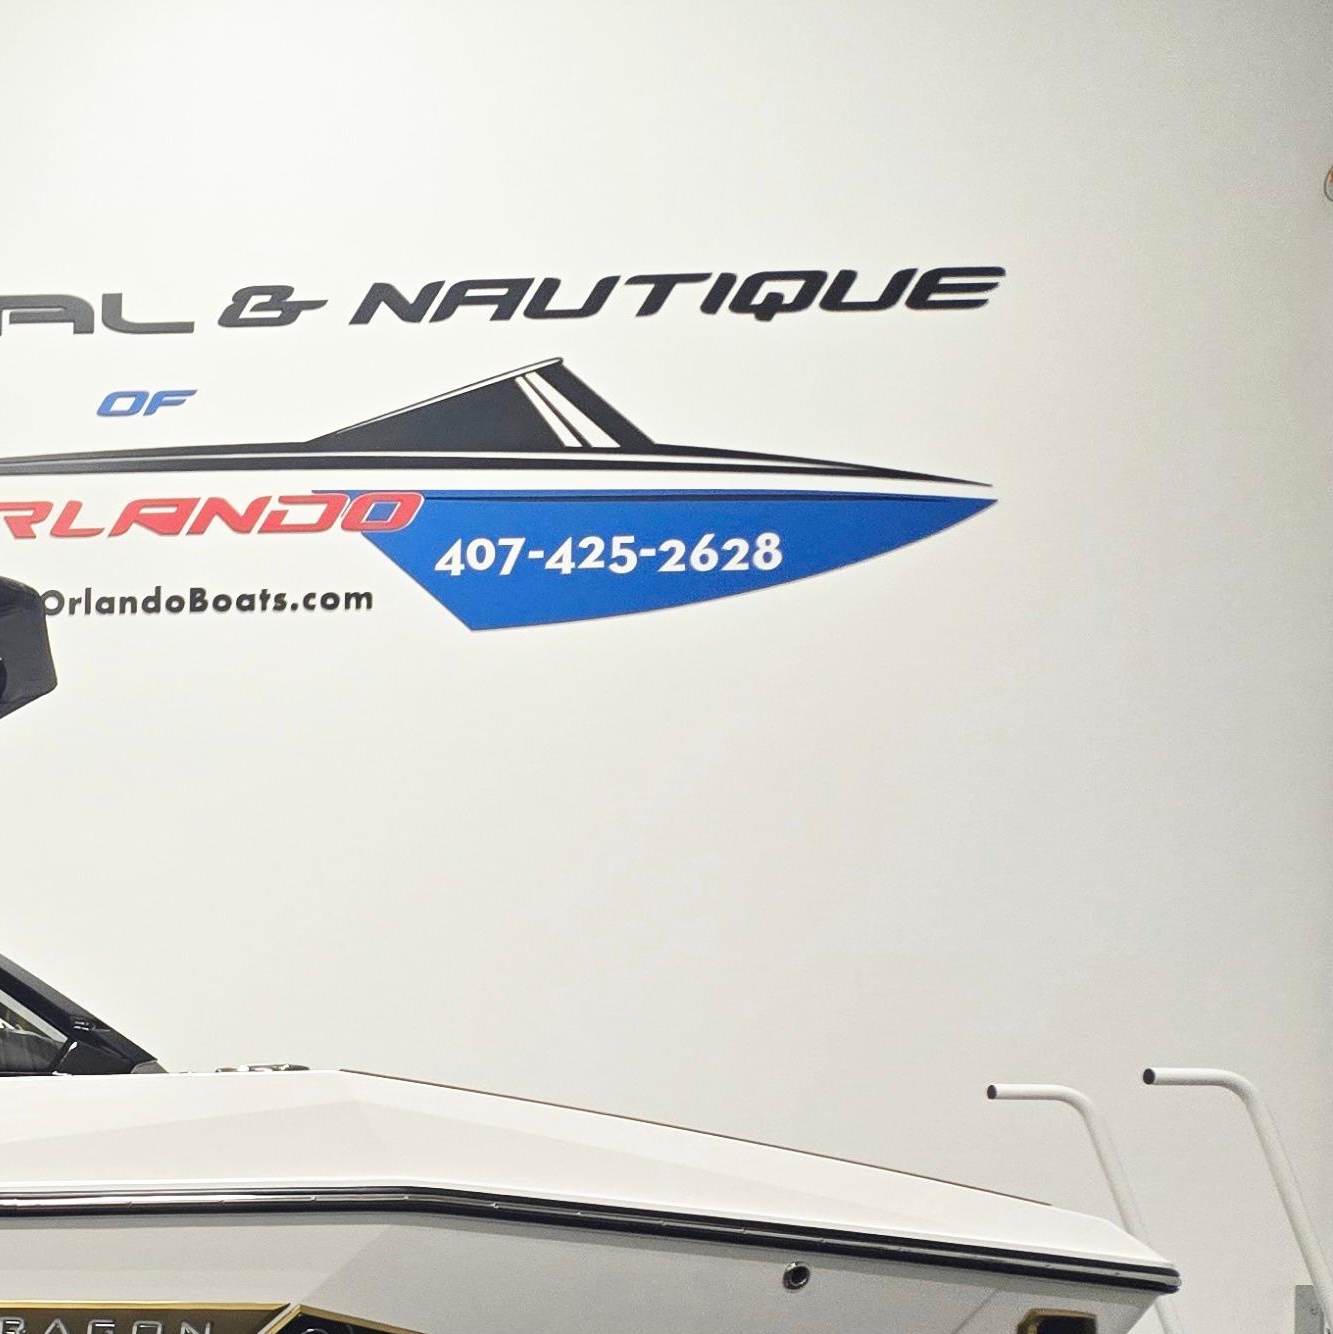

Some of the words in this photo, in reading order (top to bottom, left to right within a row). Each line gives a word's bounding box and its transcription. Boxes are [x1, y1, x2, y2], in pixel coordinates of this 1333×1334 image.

[218, 285, 329, 328] &
[349, 266, 1007, 326] NAUTIQUE
[97, 389, 198, 418] OF
[434, 532, 784, 576] 407-425-2628
[39, 585, 374, 617] OrlandoBoats.com
